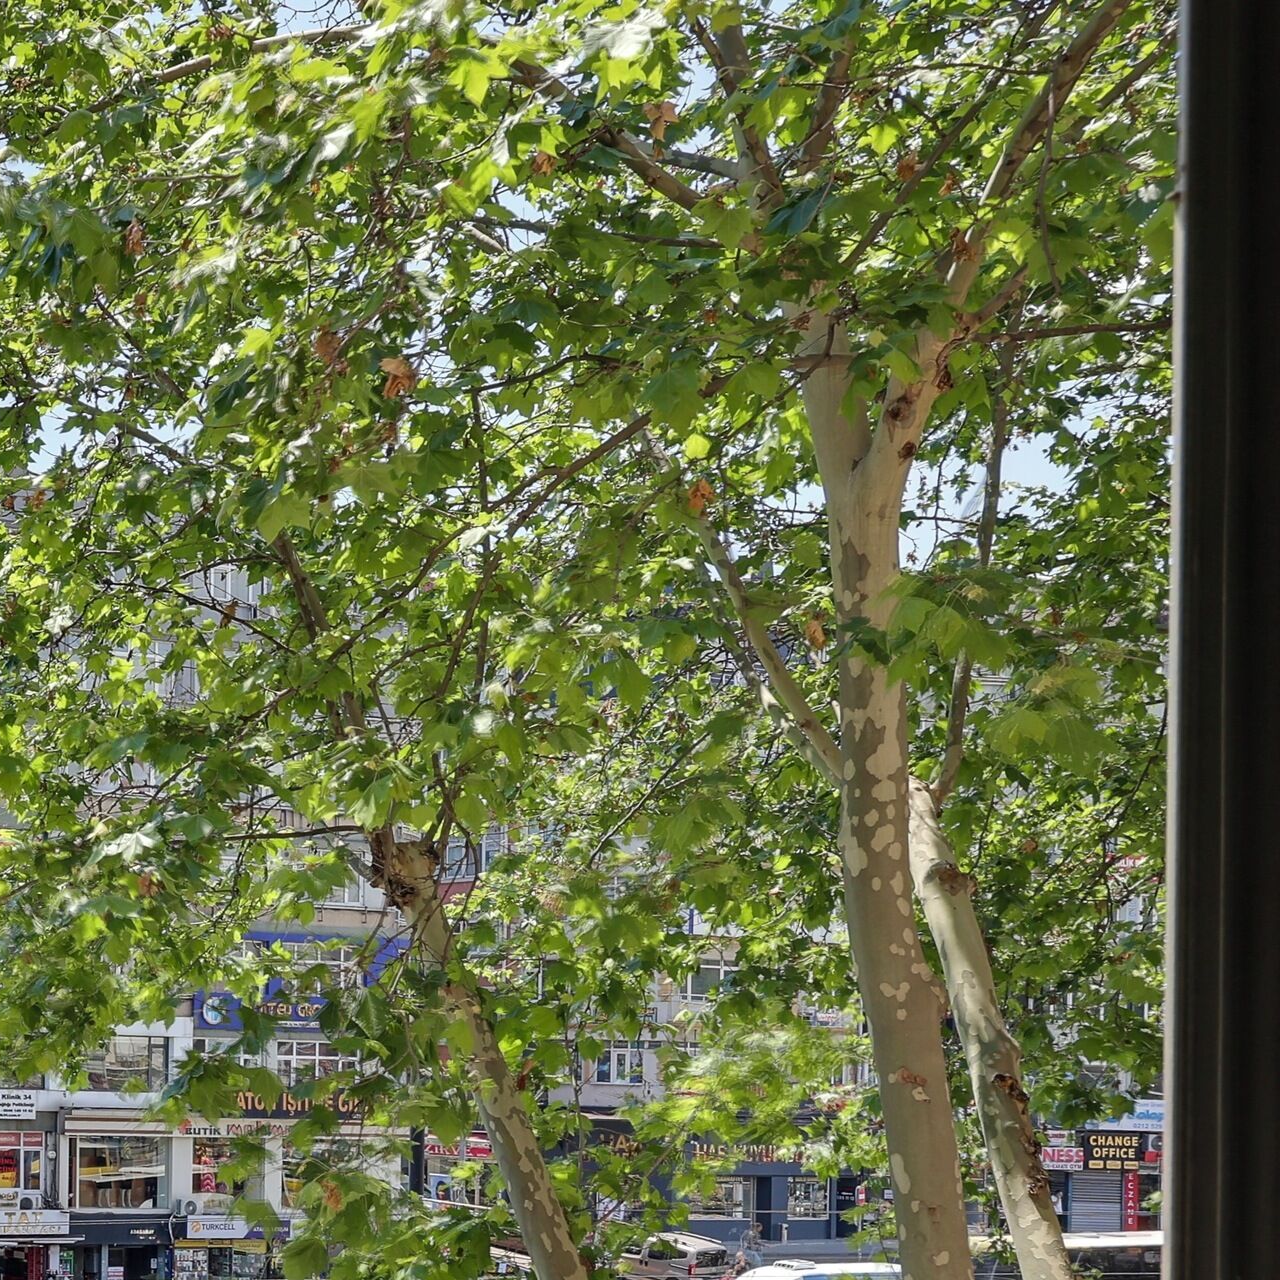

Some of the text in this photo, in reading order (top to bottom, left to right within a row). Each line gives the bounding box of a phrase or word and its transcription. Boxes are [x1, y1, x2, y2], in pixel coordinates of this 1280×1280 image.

[1090, 1135, 1139, 1146] CHANGE
[1092, 1148, 1136, 1158] OFFICE
[4, 1212, 43, 1224] TAT
[202, 1223, 236, 1232] TURKCELL
